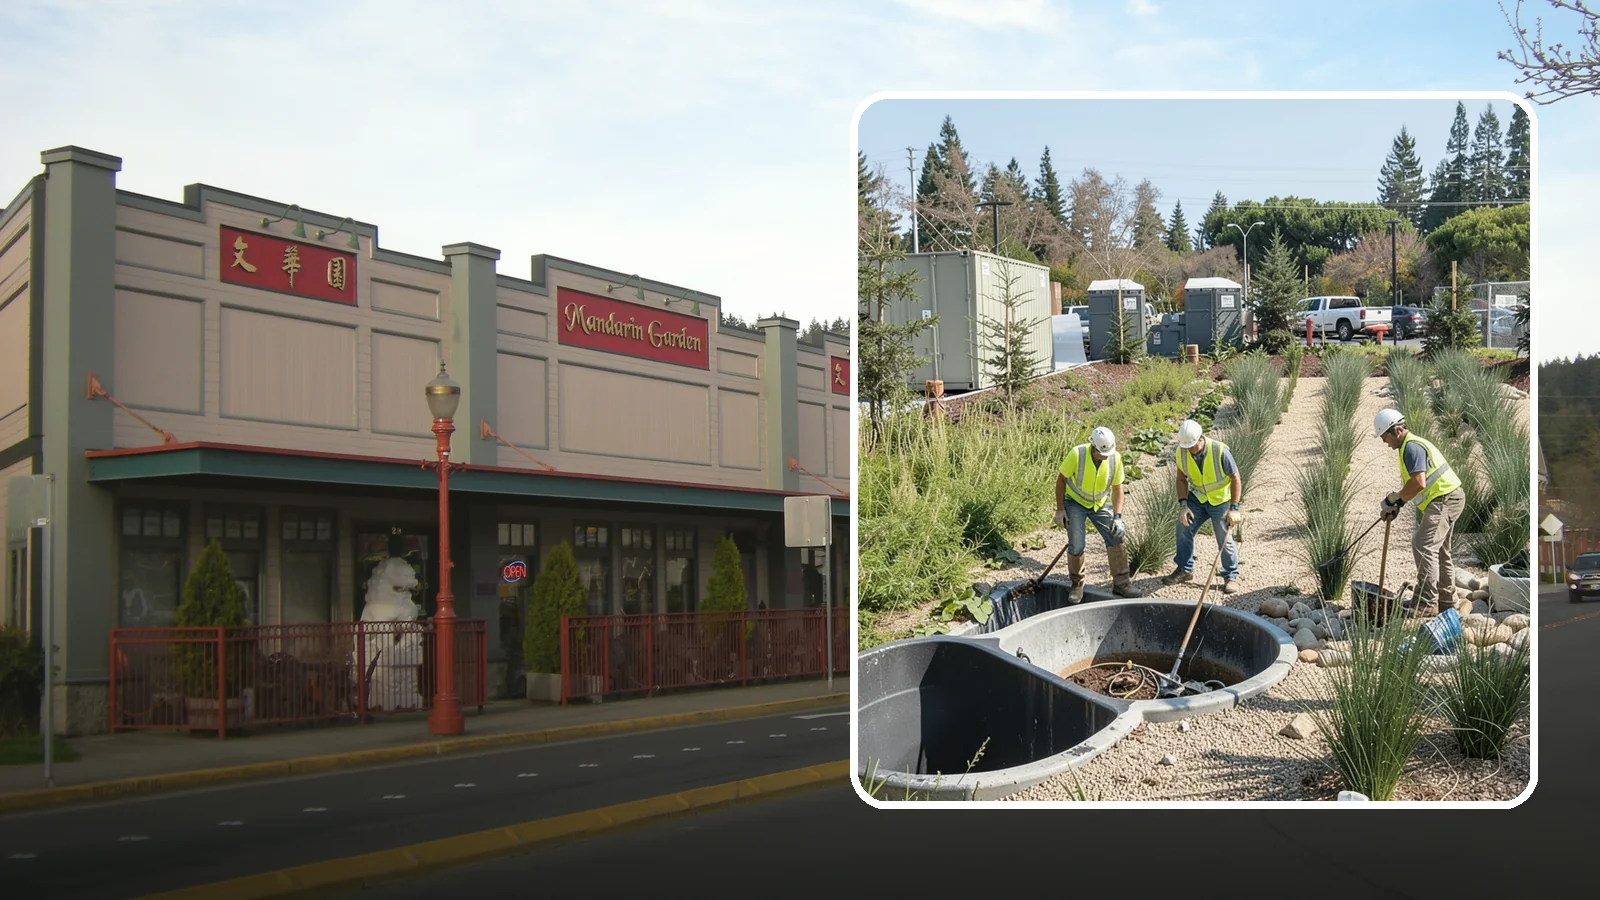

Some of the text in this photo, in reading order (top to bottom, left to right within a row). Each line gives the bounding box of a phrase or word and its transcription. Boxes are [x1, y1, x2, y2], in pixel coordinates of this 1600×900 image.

[564, 302, 702, 352] Mandarin Garden
[503, 565, 527, 578] OPEN
